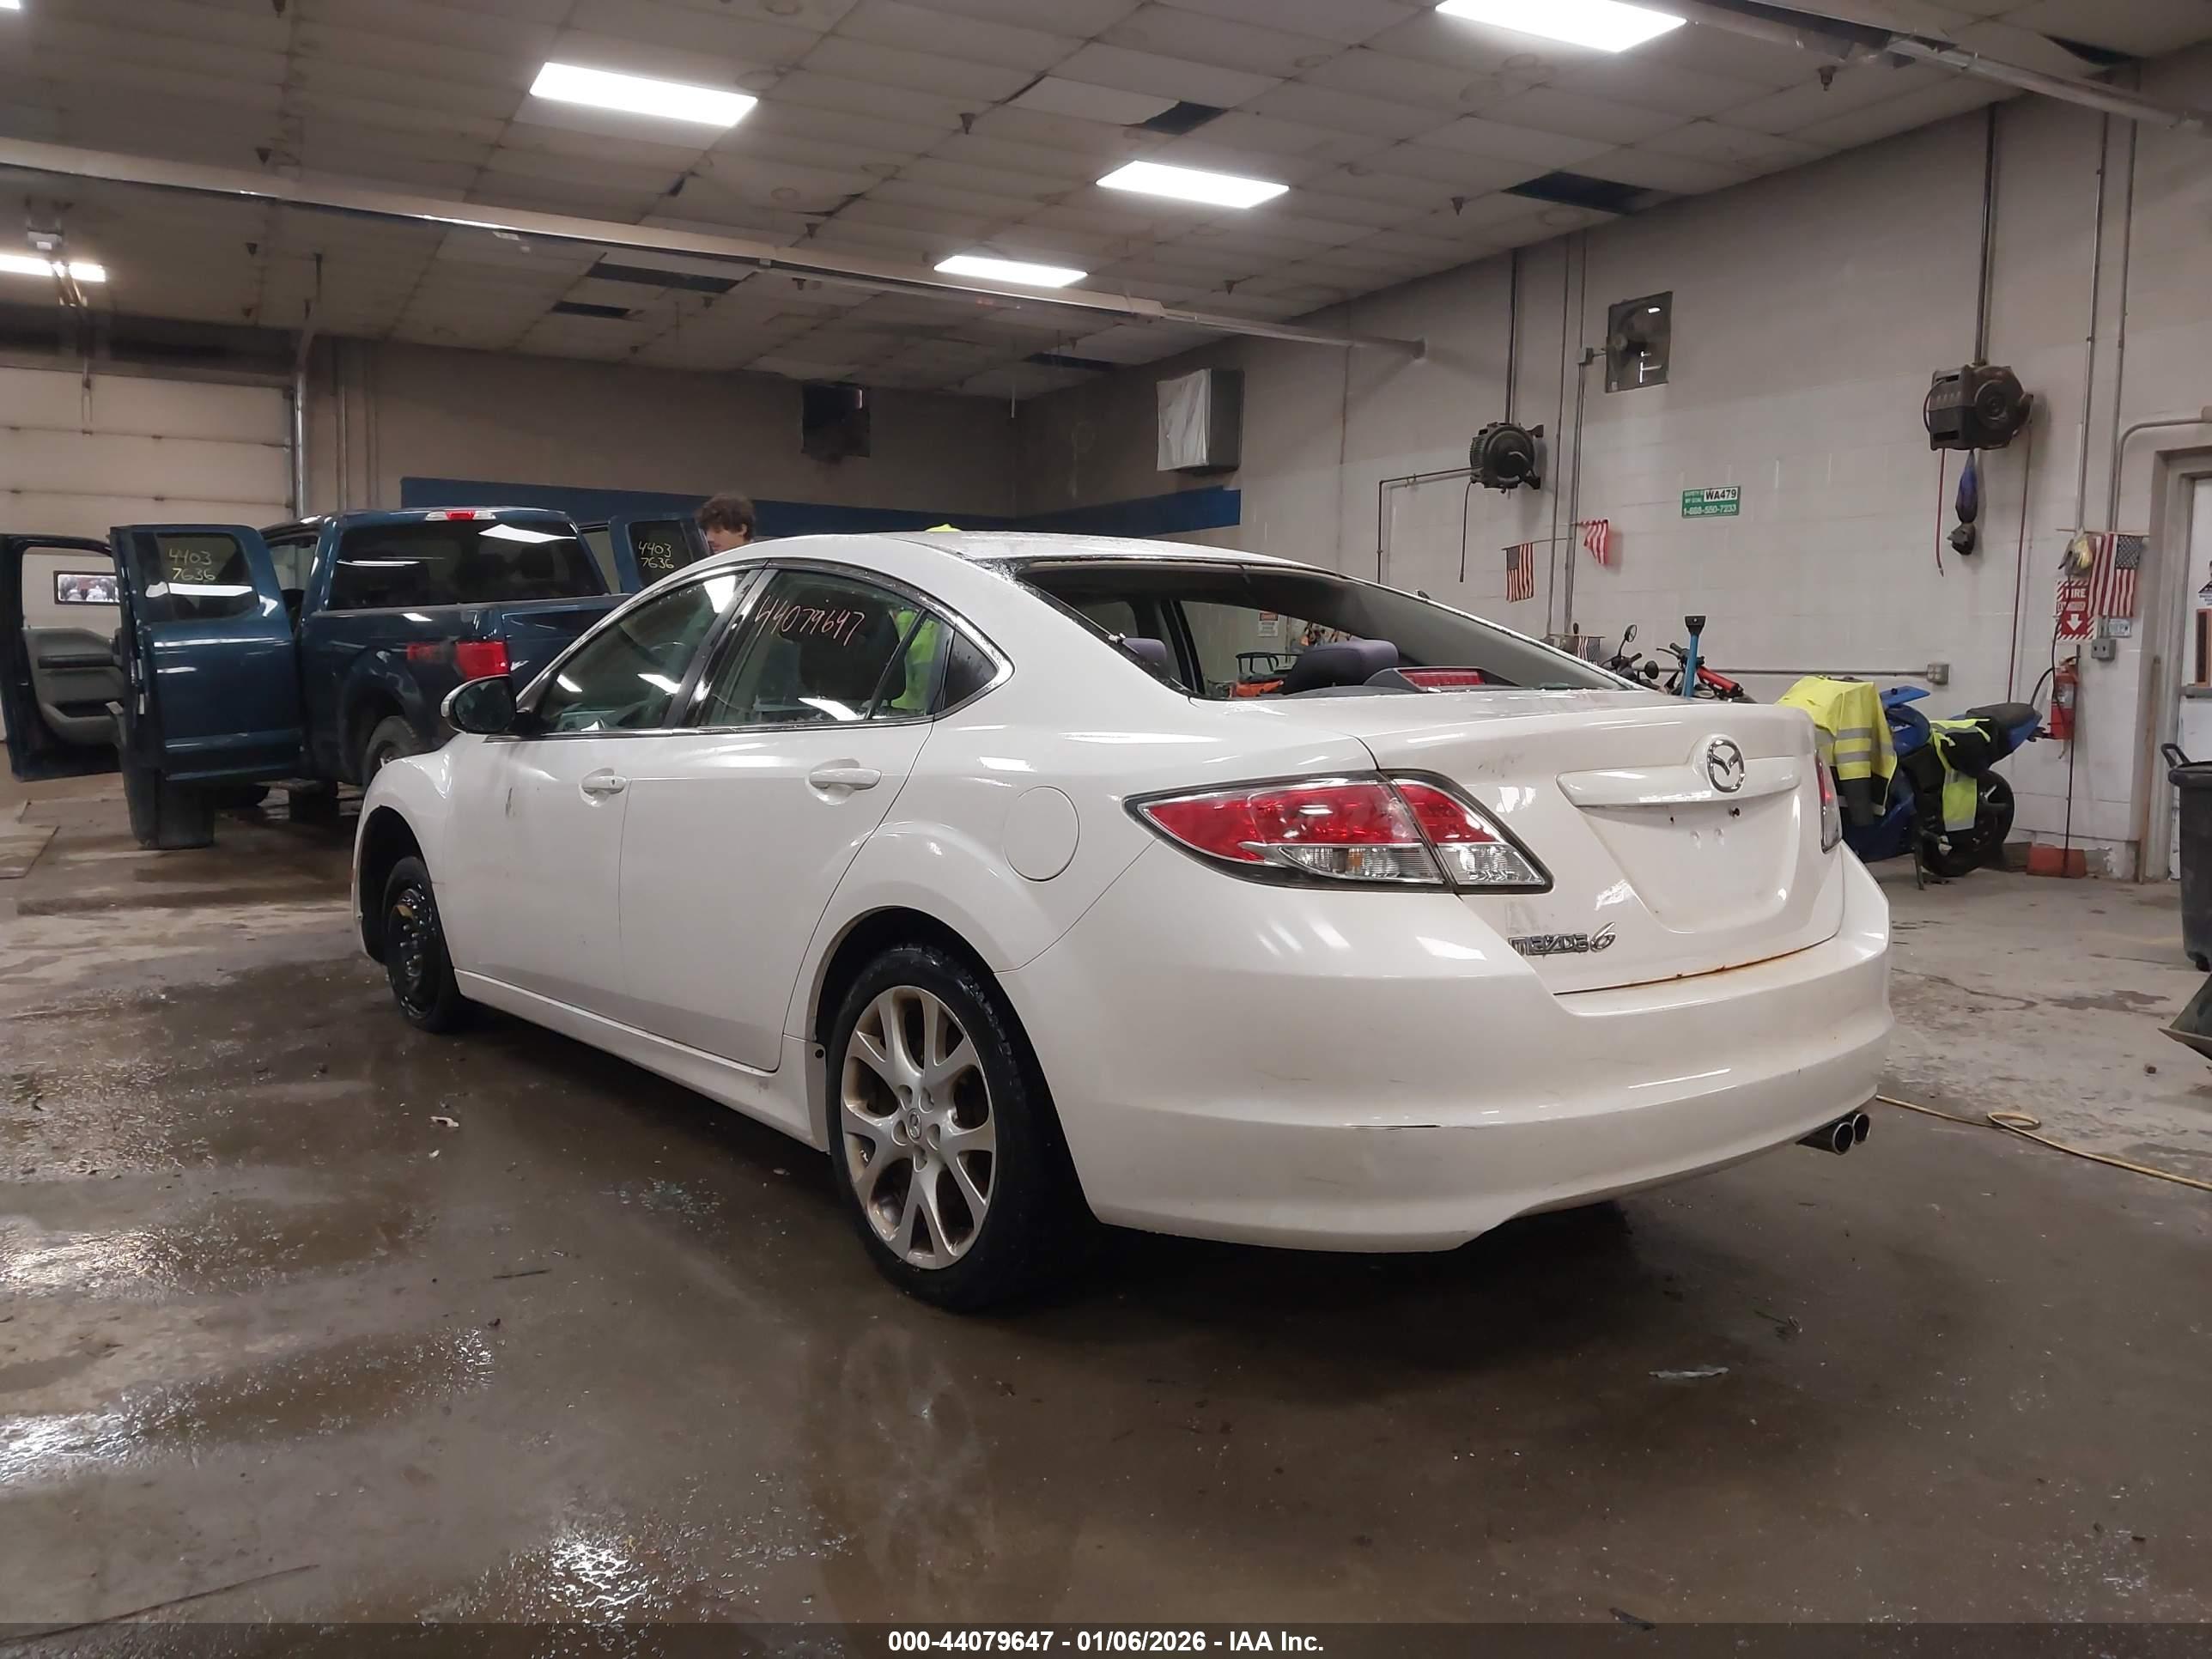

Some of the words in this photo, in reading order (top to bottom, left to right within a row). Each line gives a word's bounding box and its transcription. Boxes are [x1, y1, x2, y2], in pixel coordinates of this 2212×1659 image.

[1705, 489, 1736, 501] WA479
[638, 541, 672, 557] 4403
[168, 548, 213, 566] 4403
[641, 557, 674, 569] 7636
[172, 568, 216, 582] 7636
[755, 594, 866, 647] 44079647
